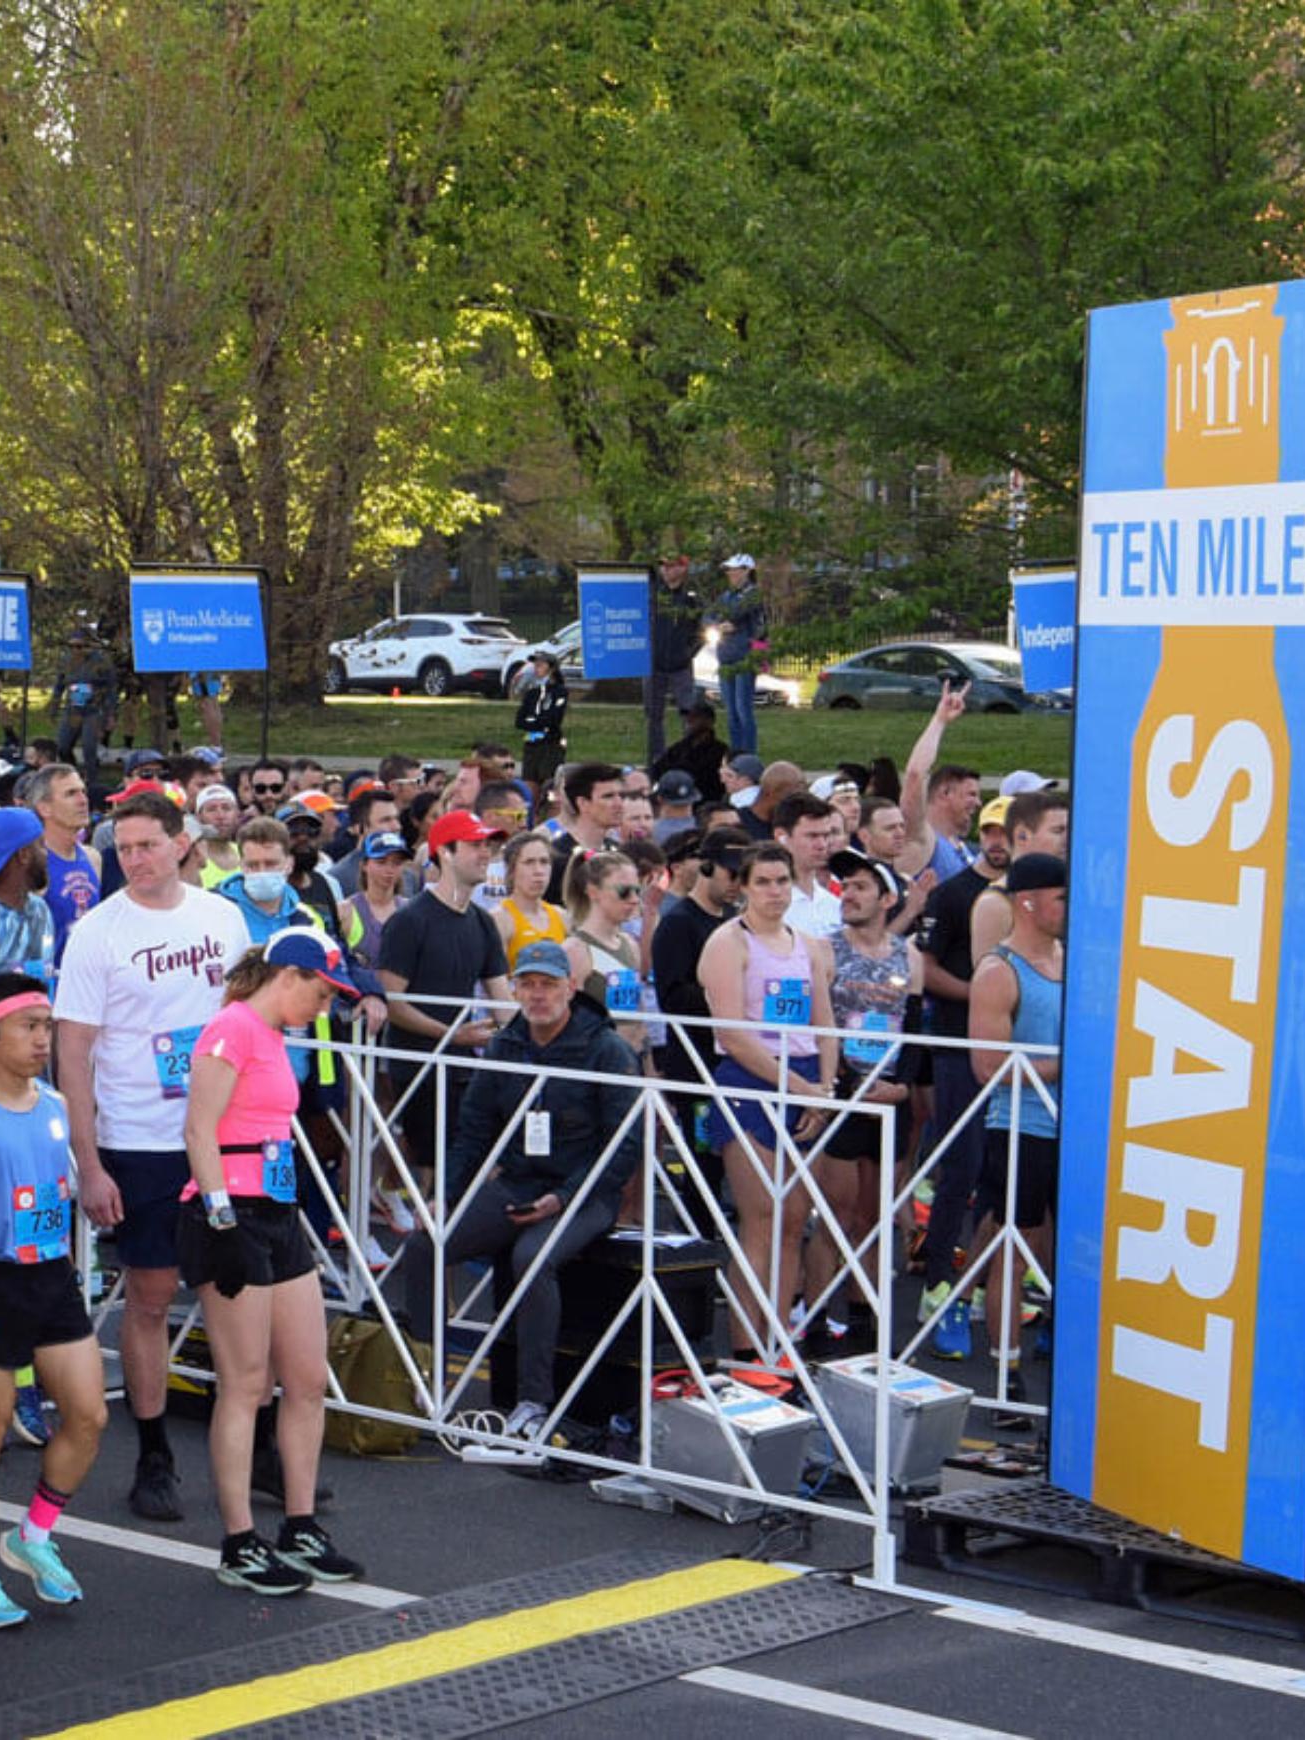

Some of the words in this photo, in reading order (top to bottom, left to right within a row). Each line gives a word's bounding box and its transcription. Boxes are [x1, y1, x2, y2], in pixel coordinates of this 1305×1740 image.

[1092, 519, 1179, 597] TEN
[1196, 514, 1305, 596] MILE
[167, 607, 197, 627] Penn
[131, 934, 224, 982] Temple
[1110, 711, 1275, 1454] START
